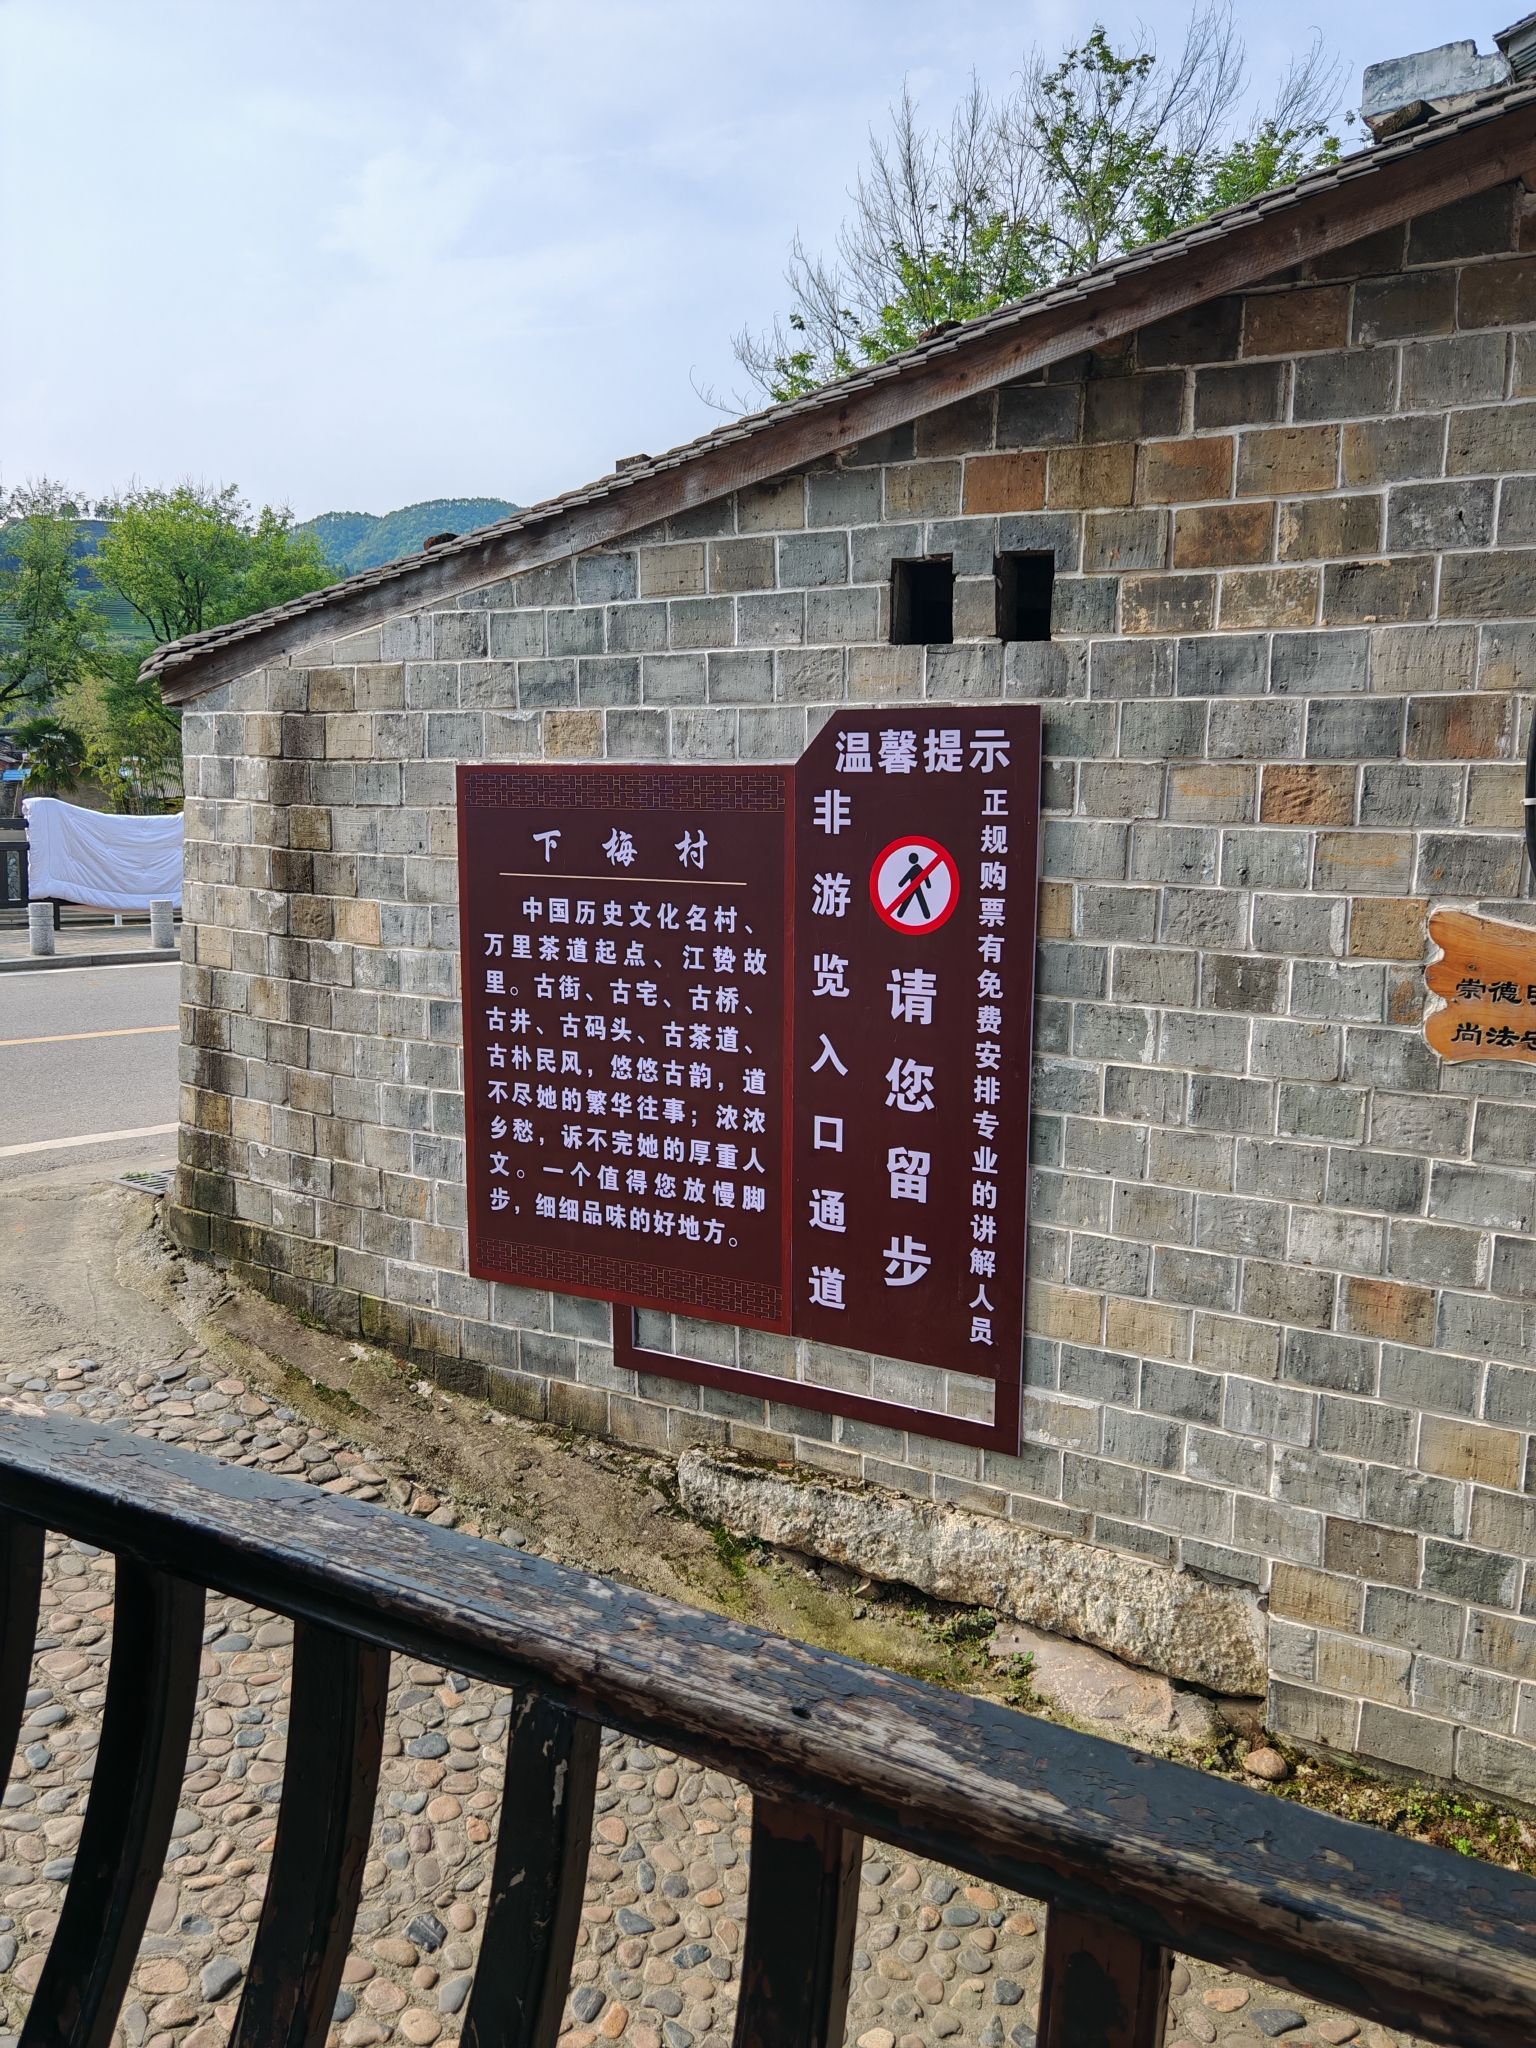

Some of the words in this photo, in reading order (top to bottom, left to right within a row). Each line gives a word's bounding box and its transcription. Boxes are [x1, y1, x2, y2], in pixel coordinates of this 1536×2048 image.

[835, 728, 1011, 774] 温馨提示
[532, 827, 709, 870] 下梅村
[522, 896, 753, 935] 中国历史文化名村、
[483, 933, 767, 976] 万里茶道起点、江贽故
[485, 969, 753, 1015] 里。古街、古宅、古桥、
[485, 1006, 753, 1055] 古井、古码头、古茶道、
[808, 789, 852, 1310] 非游览入口通道
[486, 1042, 766, 1095] 古朴民风，悠悠古韵，道
[968, 789, 1009, 1346] 正规购票有免费安排专业的讲解人员
[487, 1080, 766, 1134] 不尽她的繁华往事；浓浓
[883, 968, 937, 1286] 请您留步
[490, 1115, 765, 1174] 乡愁，诉不完她的厚重人
[489, 1151, 765, 1213] 文。一个值得您放慢脚
[489, 1187, 738, 1248] 步，细细品味的好地方。
